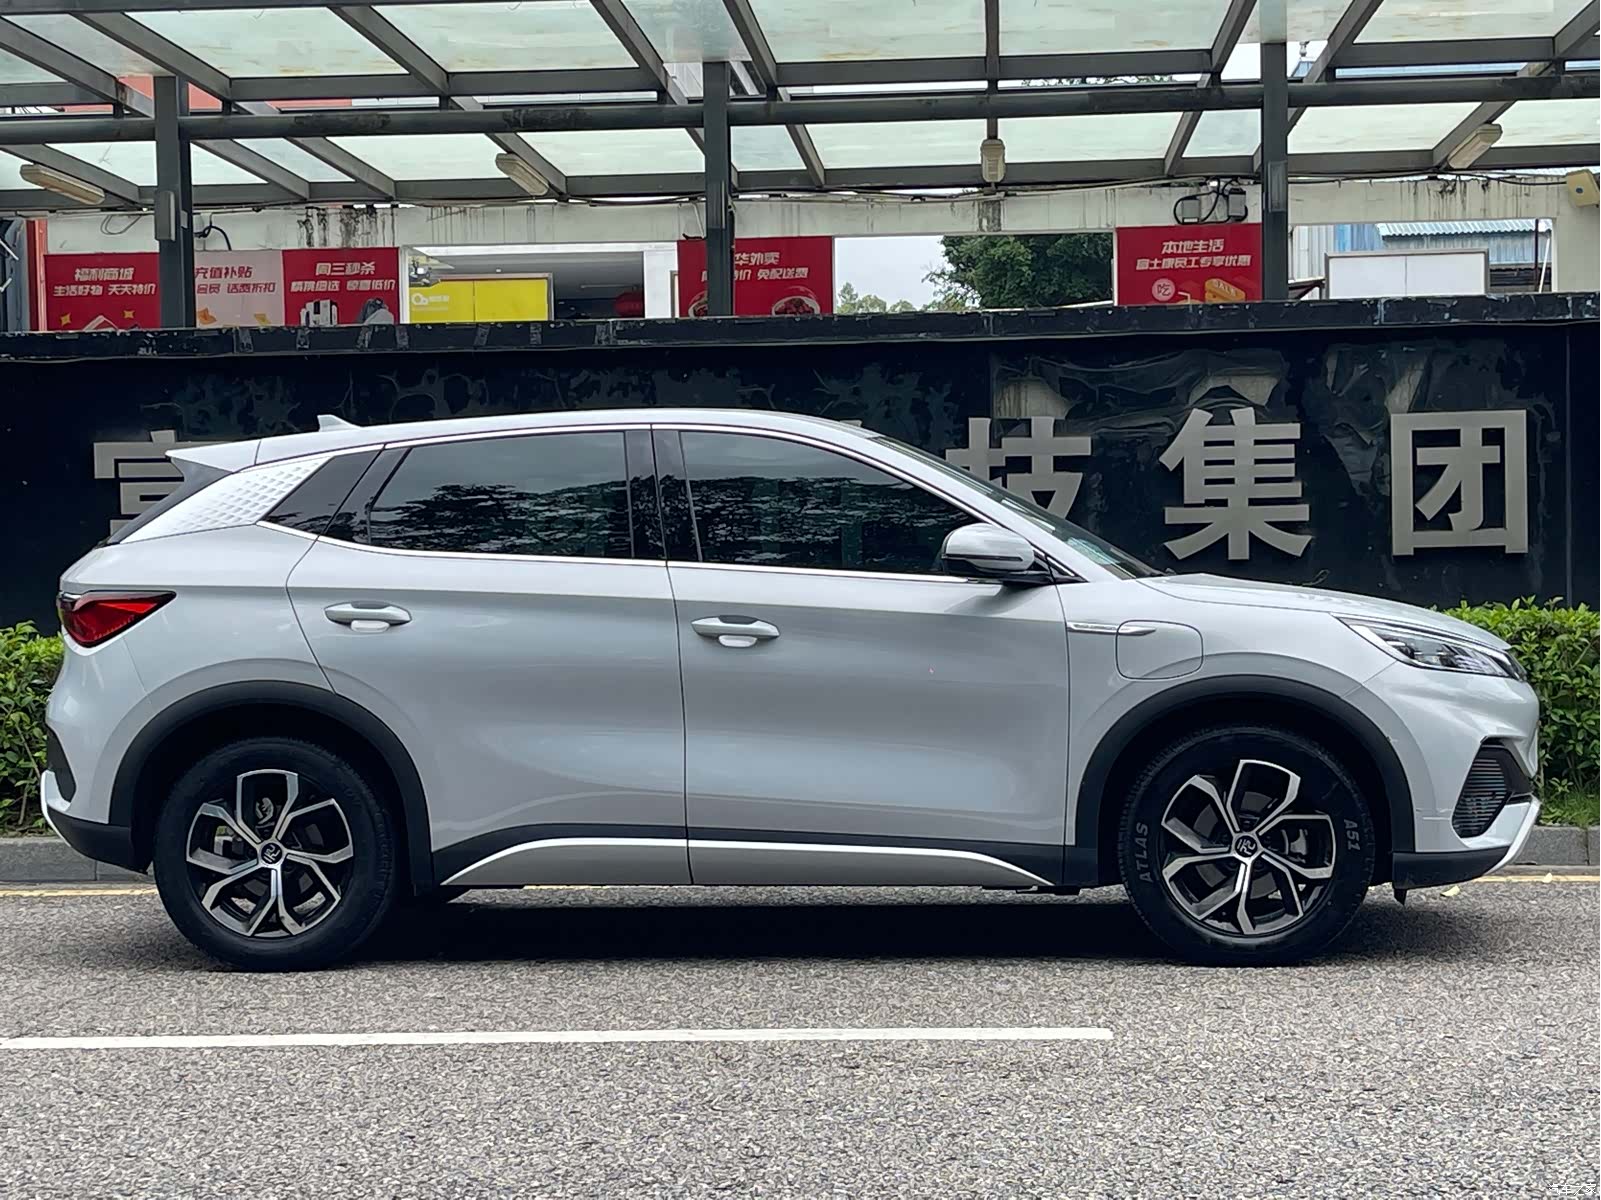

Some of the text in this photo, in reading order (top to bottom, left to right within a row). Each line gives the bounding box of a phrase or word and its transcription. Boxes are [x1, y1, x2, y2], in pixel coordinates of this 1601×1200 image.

[1161, 239, 1224, 254] 本地生活
[315, 262, 376, 276] 周三秒杀
[1136, 255, 1251, 270] 富士康员工专享优惠
[75, 267, 134, 281] 福利商城
[195, 266, 252, 279] 充值补贴
[53, 283, 156, 296] 生活好物 天天特价
[1157, 283, 1171, 297] 吃
[1134, 821, 1153, 883] ATLAS
